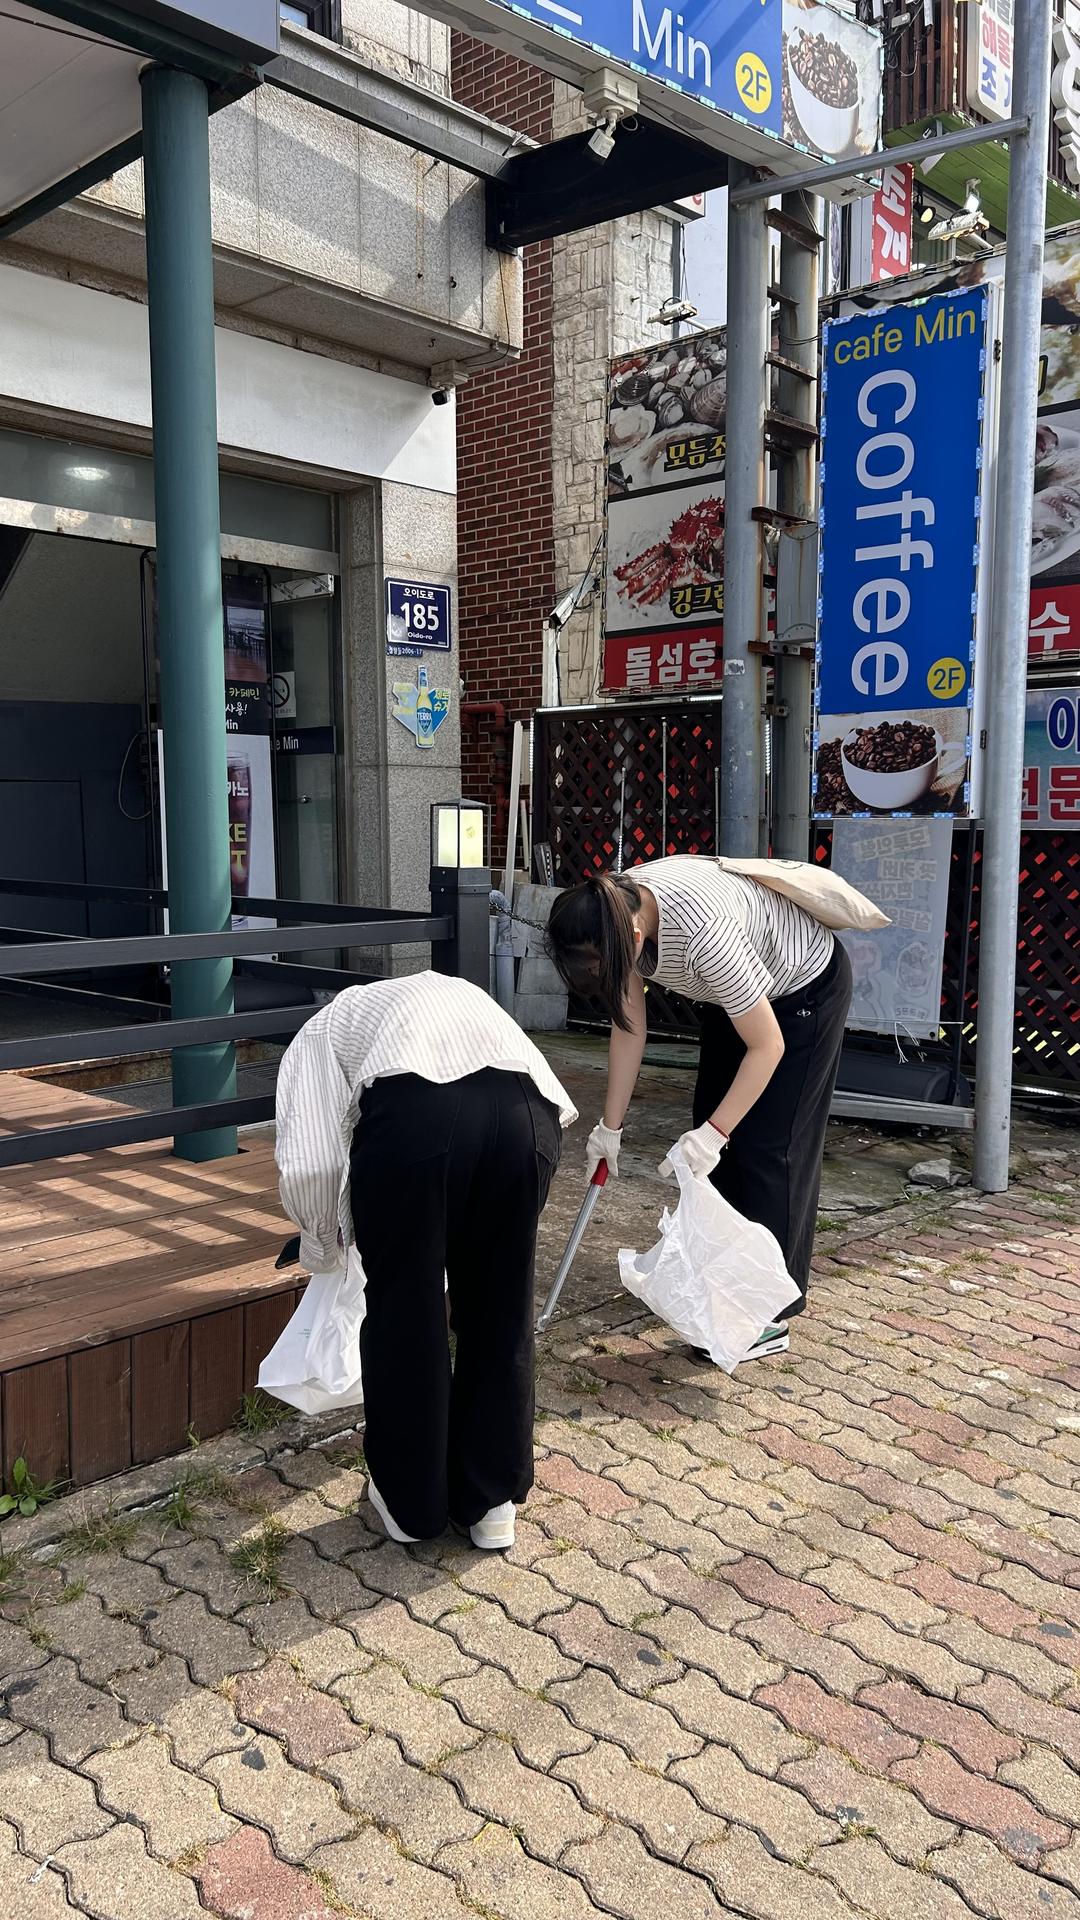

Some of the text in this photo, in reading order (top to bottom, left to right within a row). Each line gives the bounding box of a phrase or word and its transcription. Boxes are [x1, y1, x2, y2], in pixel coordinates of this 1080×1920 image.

[632, 0, 712, 87] Min
[741, 64, 767, 101] 2F
[876, 166, 907, 280] 조개
[834, 306, 976, 365] cafe Min
[851, 369, 935, 696] coffee
[403, 587, 435, 601] 오이도로
[400, 602, 440, 631] 185
[1028, 601, 1070, 650] 수
[407, 631, 433, 641] Oido-ro
[625, 638, 717, 687] 돌섬호
[933, 667, 961, 690] 2F
[229, 687, 260, 700] 카페민
[283, 736, 299, 750] Min
